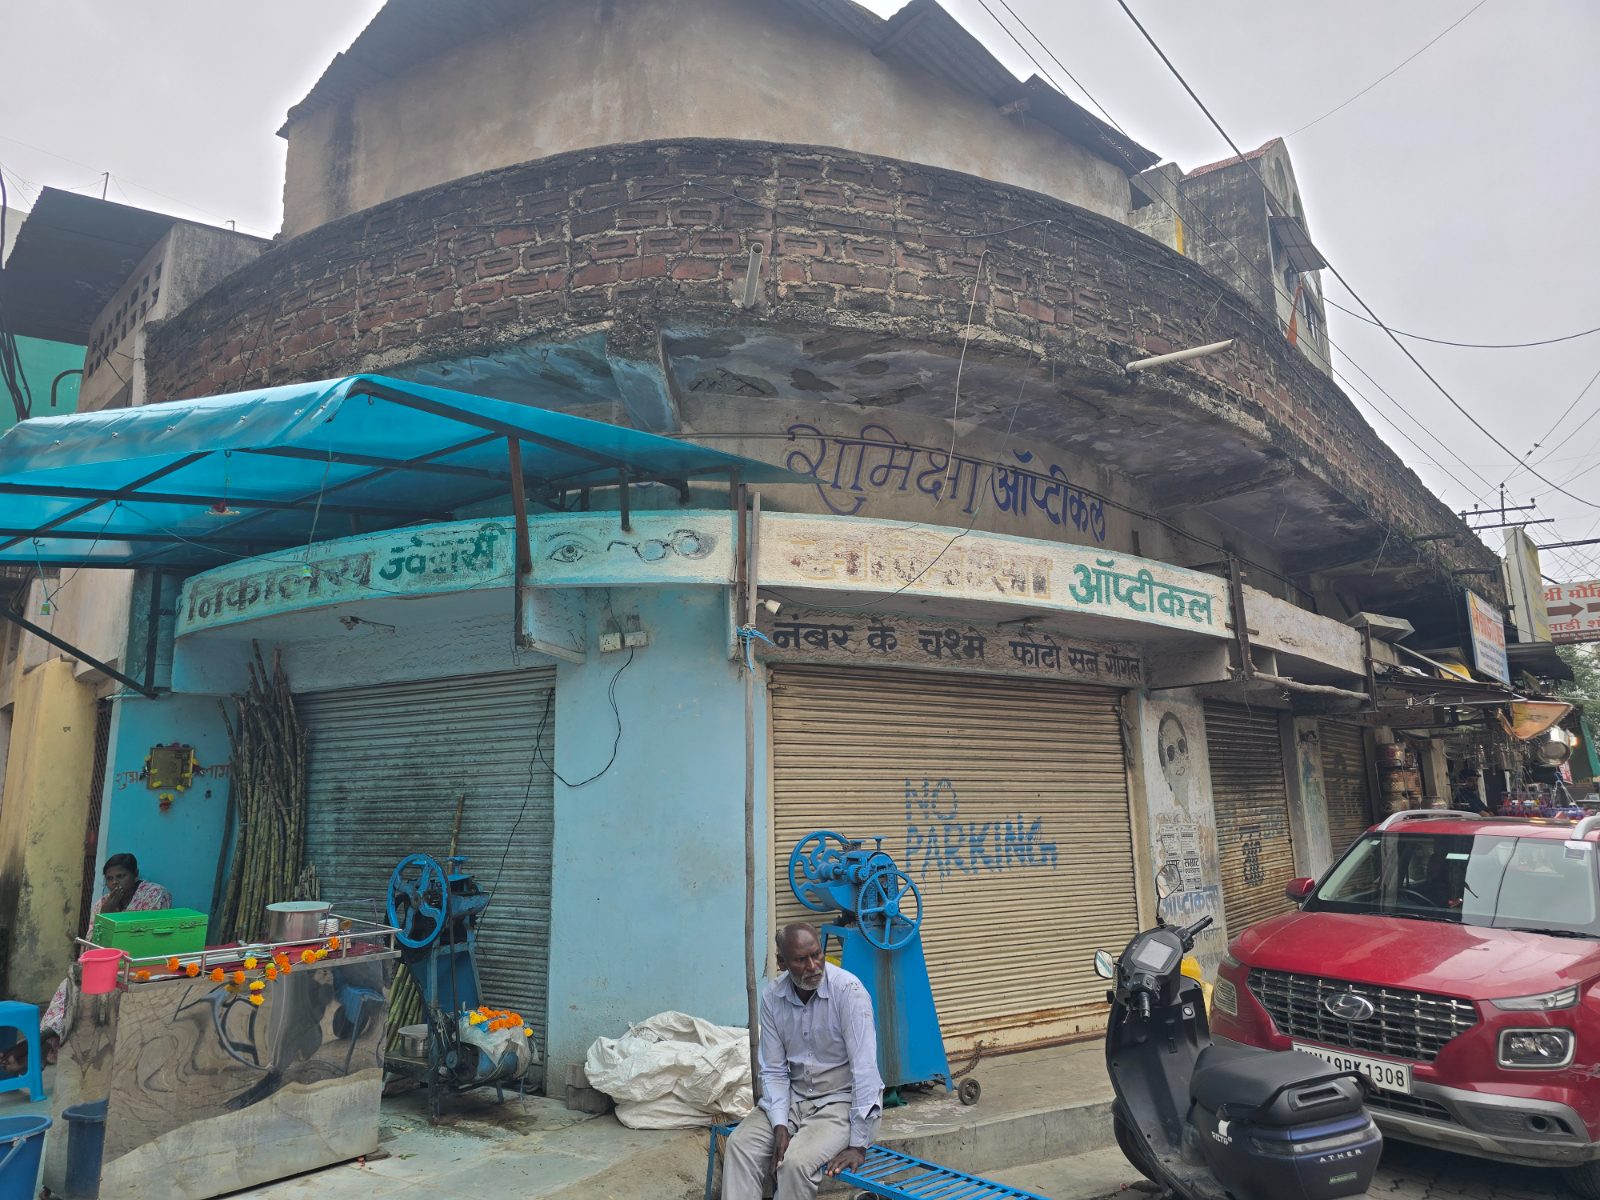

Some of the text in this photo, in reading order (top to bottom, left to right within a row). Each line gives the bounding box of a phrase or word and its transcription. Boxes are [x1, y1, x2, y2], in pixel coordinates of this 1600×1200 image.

[1068, 559, 1214, 625] ऑप्टीकल
[773, 613, 853, 650] नंबर
[867, 618, 896, 652] के
[918, 626, 987, 660] चश्मे
[1008, 632, 1061, 670] फोटो
[905, 778, 957, 820] NO
[1319, 1149, 1362, 1162] ATHER
